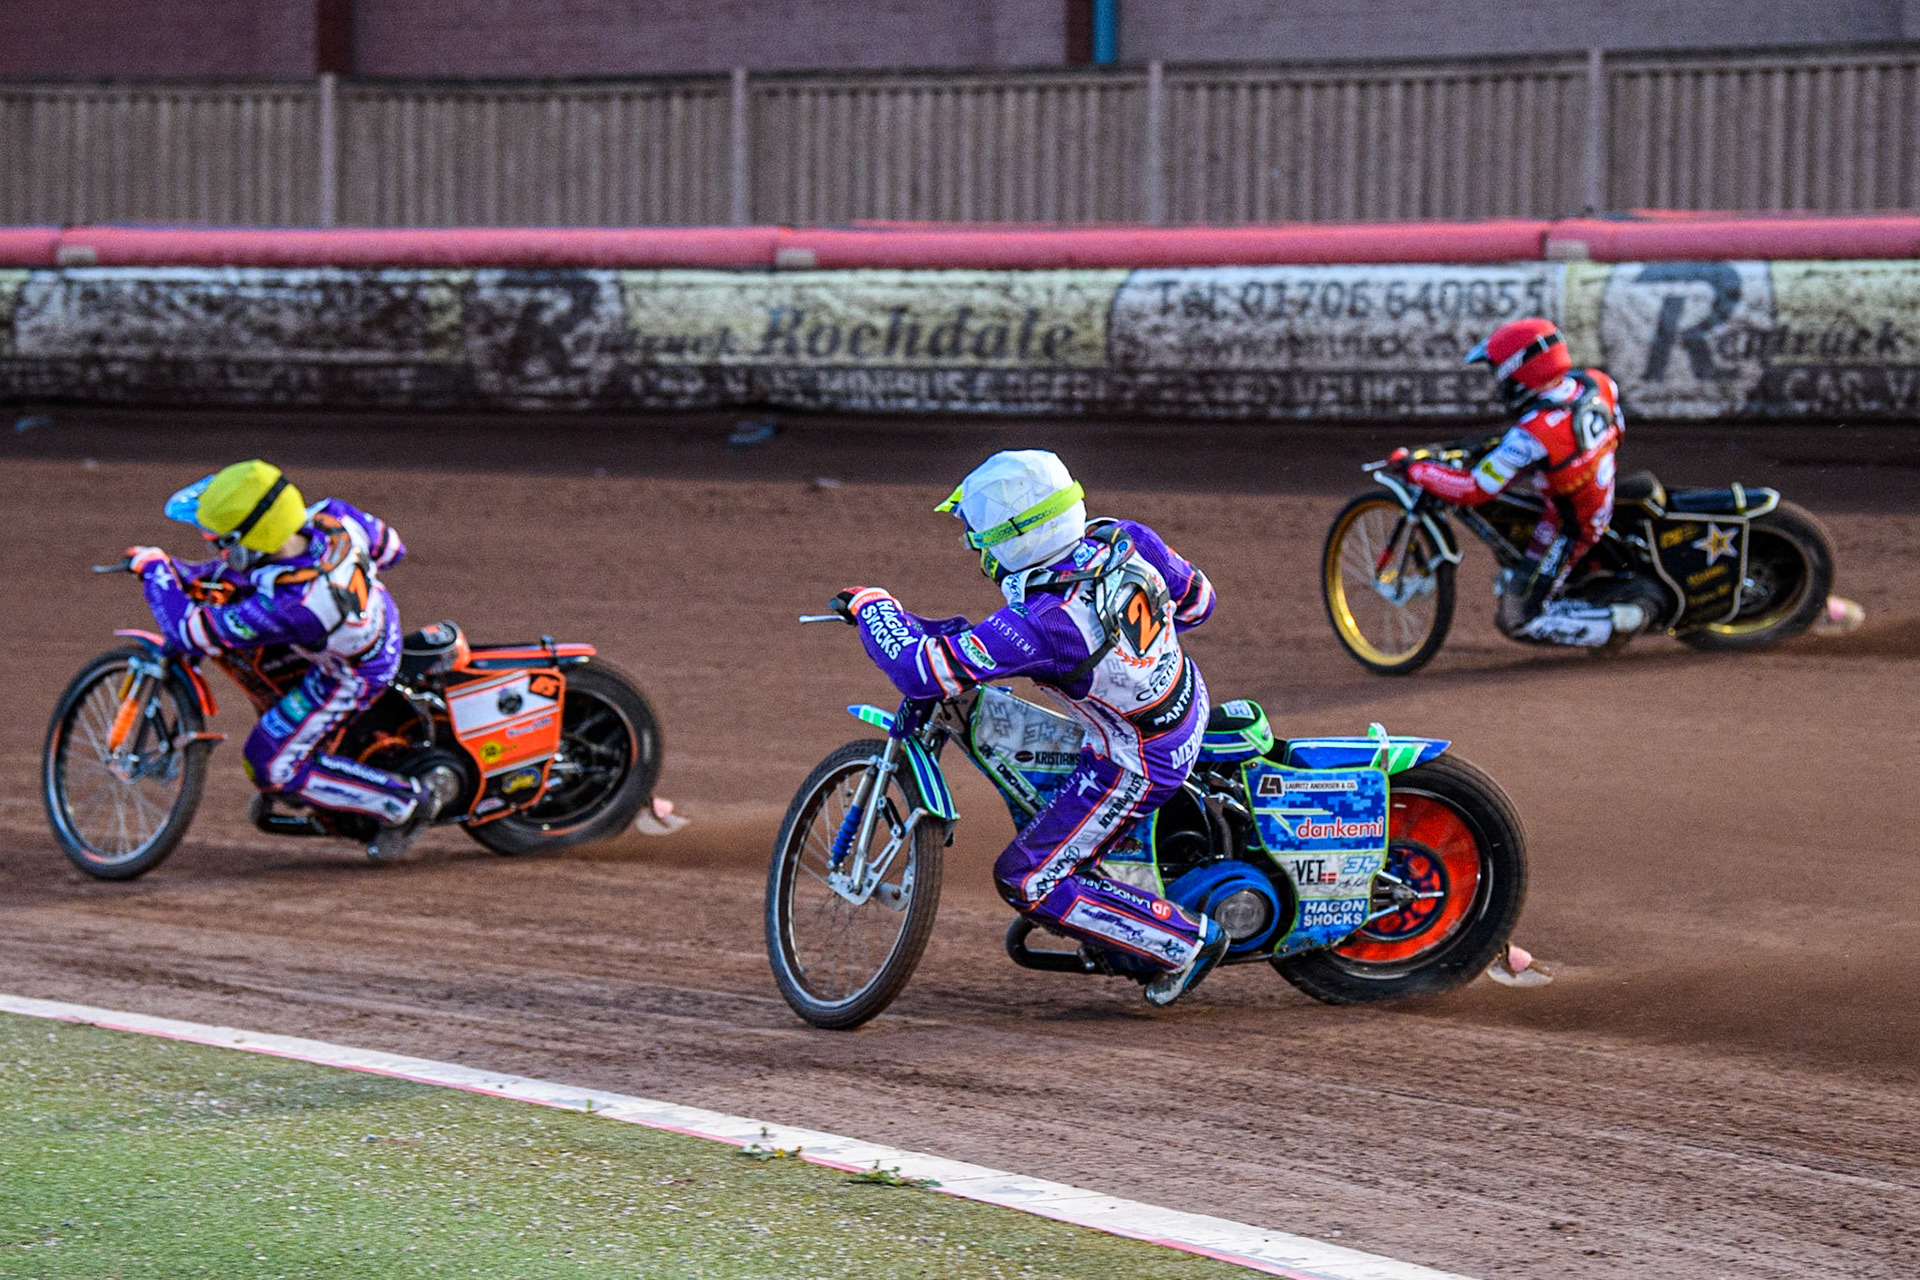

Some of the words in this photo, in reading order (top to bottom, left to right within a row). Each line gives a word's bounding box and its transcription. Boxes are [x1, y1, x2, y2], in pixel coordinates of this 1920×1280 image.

[1241, 279, 1372, 319] 01706
[1385, 278, 1547, 319] 640055
[757, 304, 1078, 360] Rochdale
[861, 604, 902, 661] SHOCKS
[875, 599, 919, 648] HAGON
[1127, 590, 1161, 652] 2
[1297, 817, 1384, 838] dankemi
[1295, 860, 1325, 883] VET
[1151, 902, 1169, 916] JD
[1303, 913, 1363, 928] SHOCKS
[1304, 900, 1366, 914] HAGON
